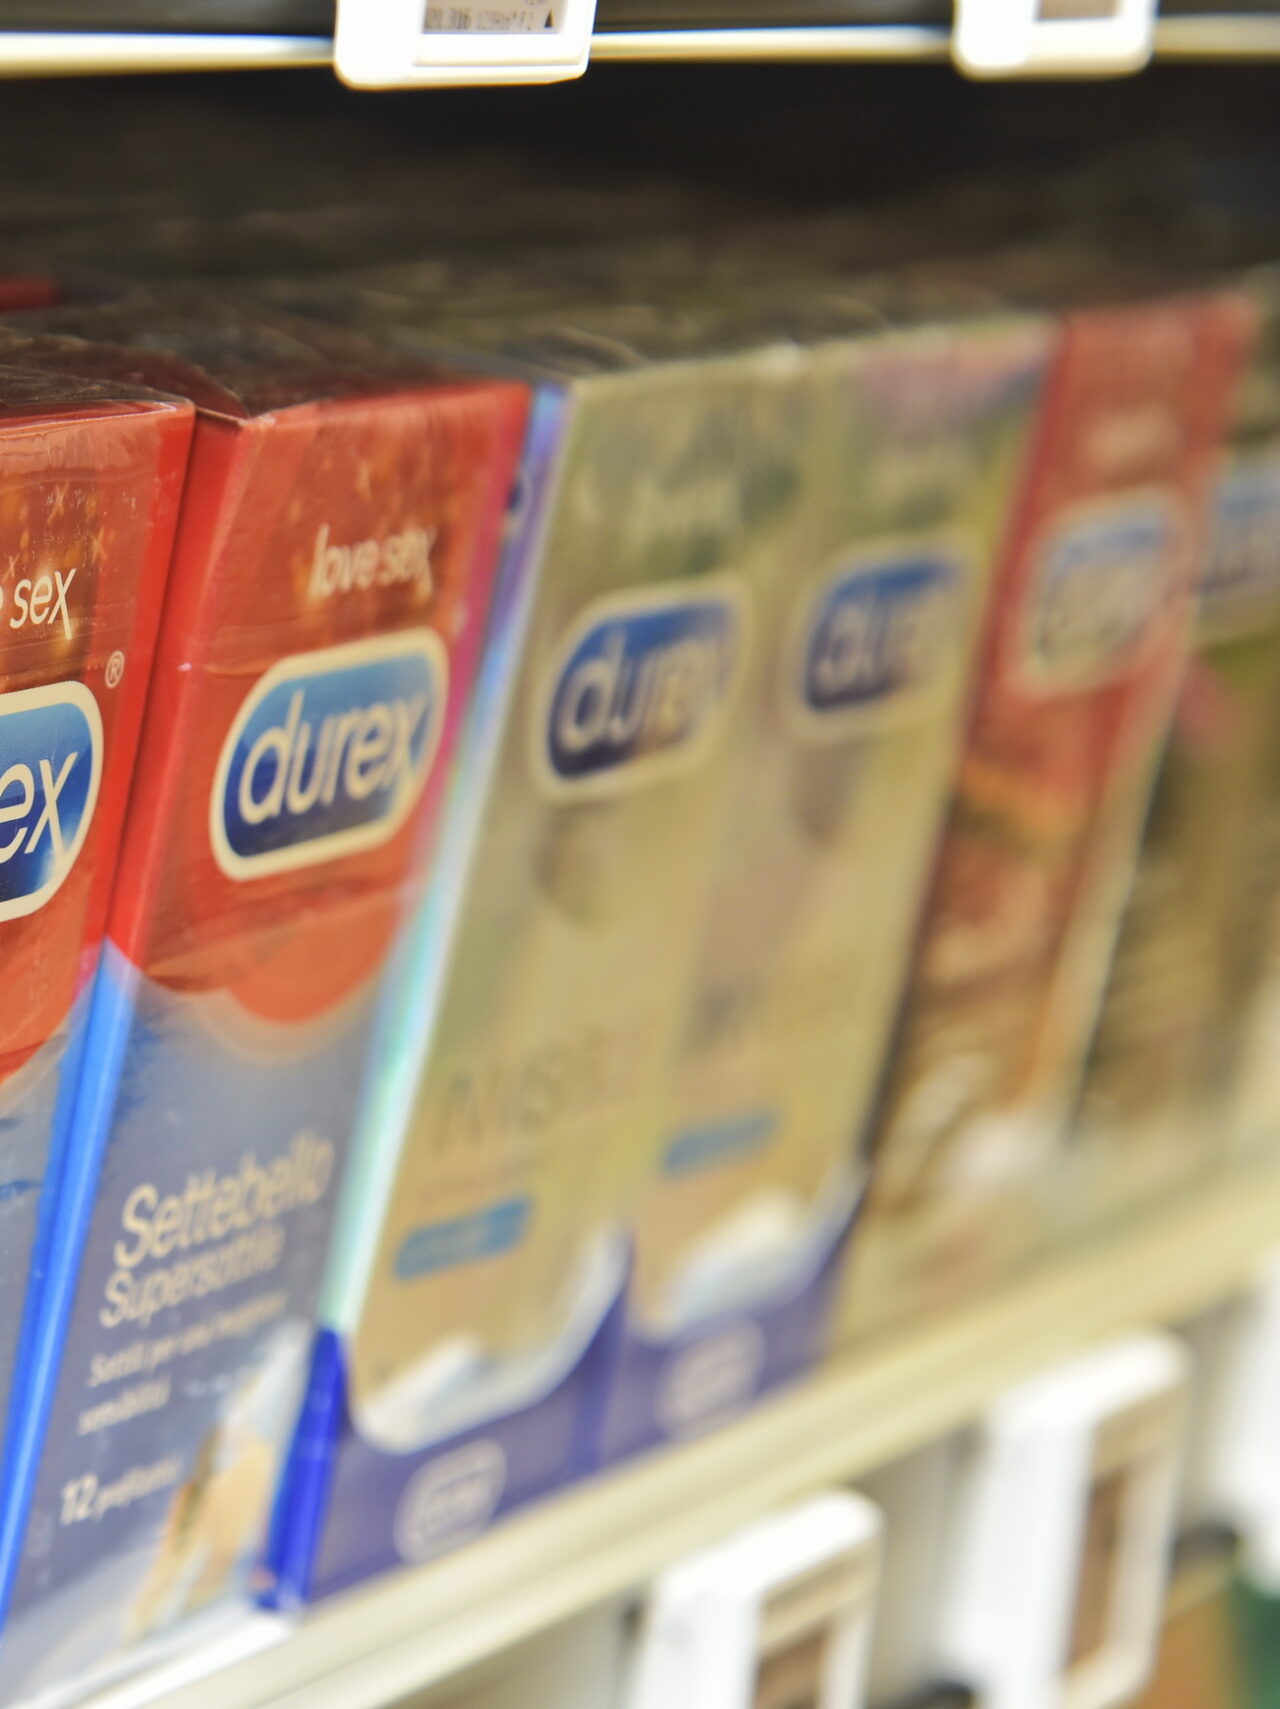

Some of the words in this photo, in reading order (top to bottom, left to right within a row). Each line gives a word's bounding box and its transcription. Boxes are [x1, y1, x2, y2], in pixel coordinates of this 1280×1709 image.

[10, 567, 77, 641] sex
[308, 523, 379, 602] love
[237, 687, 431, 827] durex
[113, 1128, 335, 1268] Settebello
